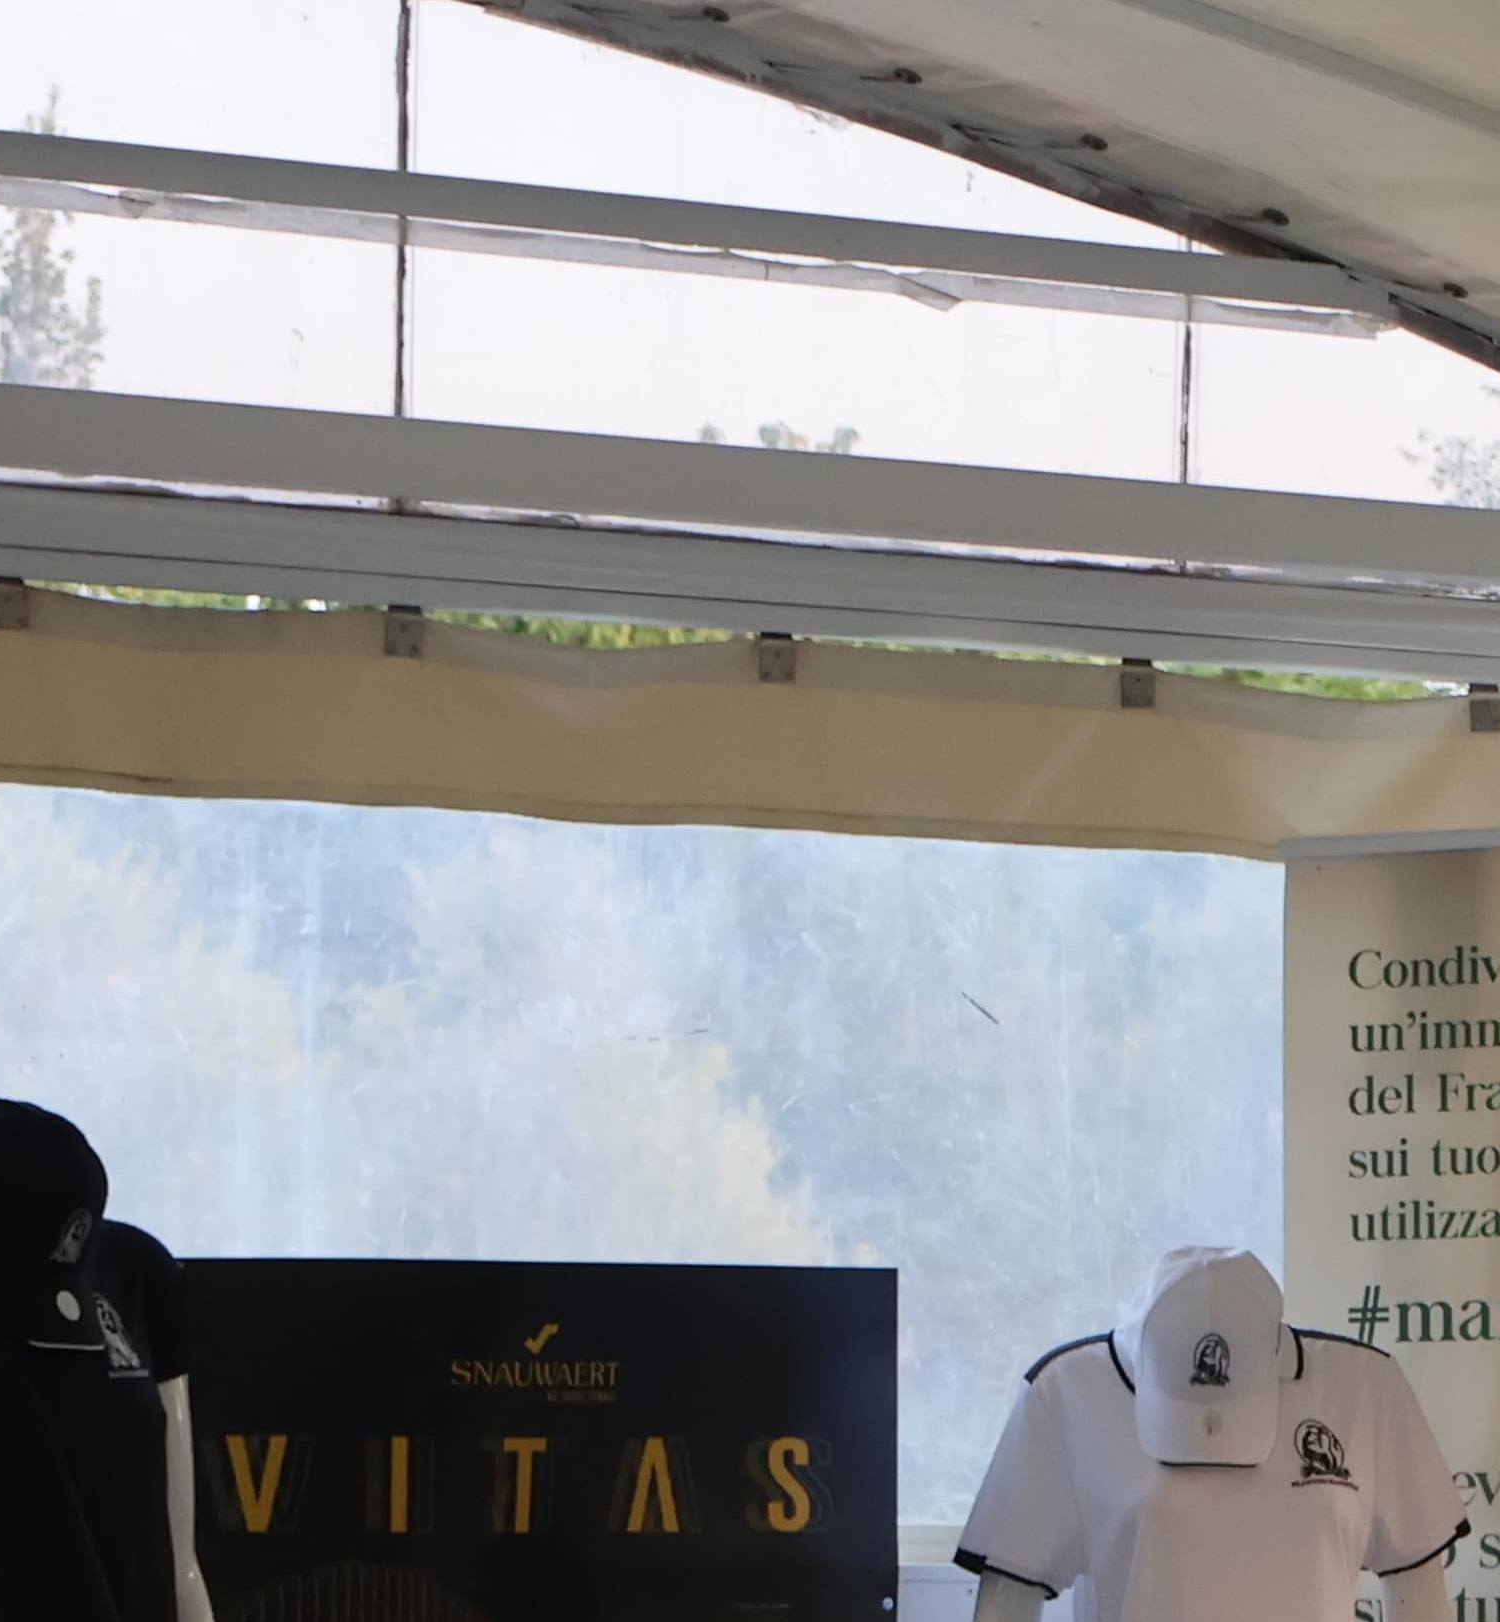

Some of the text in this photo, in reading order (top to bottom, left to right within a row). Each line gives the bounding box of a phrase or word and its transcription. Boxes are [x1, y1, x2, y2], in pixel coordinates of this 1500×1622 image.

[1349, 1075, 1415, 1115] del
[1349, 1137, 1410, 1178] sui
[450, 1360, 620, 1388] SNAUWAERT
